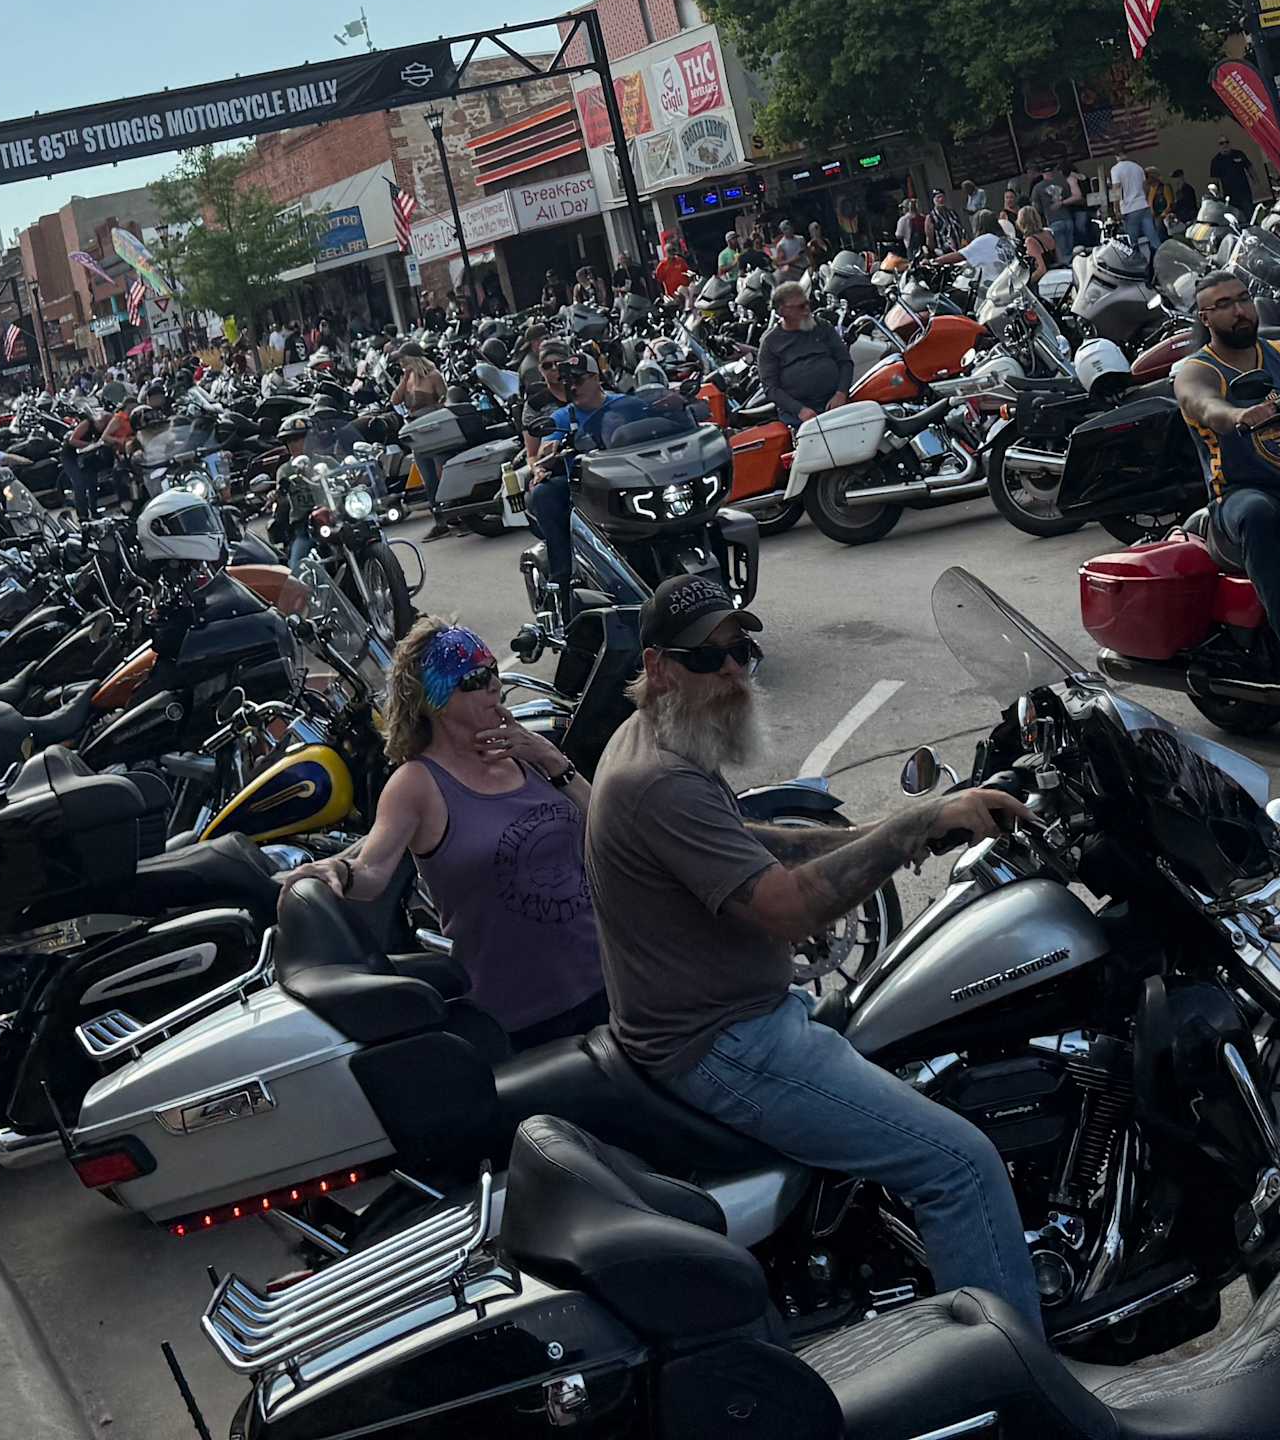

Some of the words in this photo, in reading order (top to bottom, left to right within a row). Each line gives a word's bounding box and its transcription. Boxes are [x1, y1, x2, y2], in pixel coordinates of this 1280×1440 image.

[683, 51, 717, 88] THC
[39, 129, 81, 163] 85TH
[81, 114, 164, 155] STURGIS
[166, 90, 286, 139] MOTORCYCLE
[287, 78, 338, 114] RALLY
[535, 206, 558, 223] All
[559, 197, 589, 217] Day
